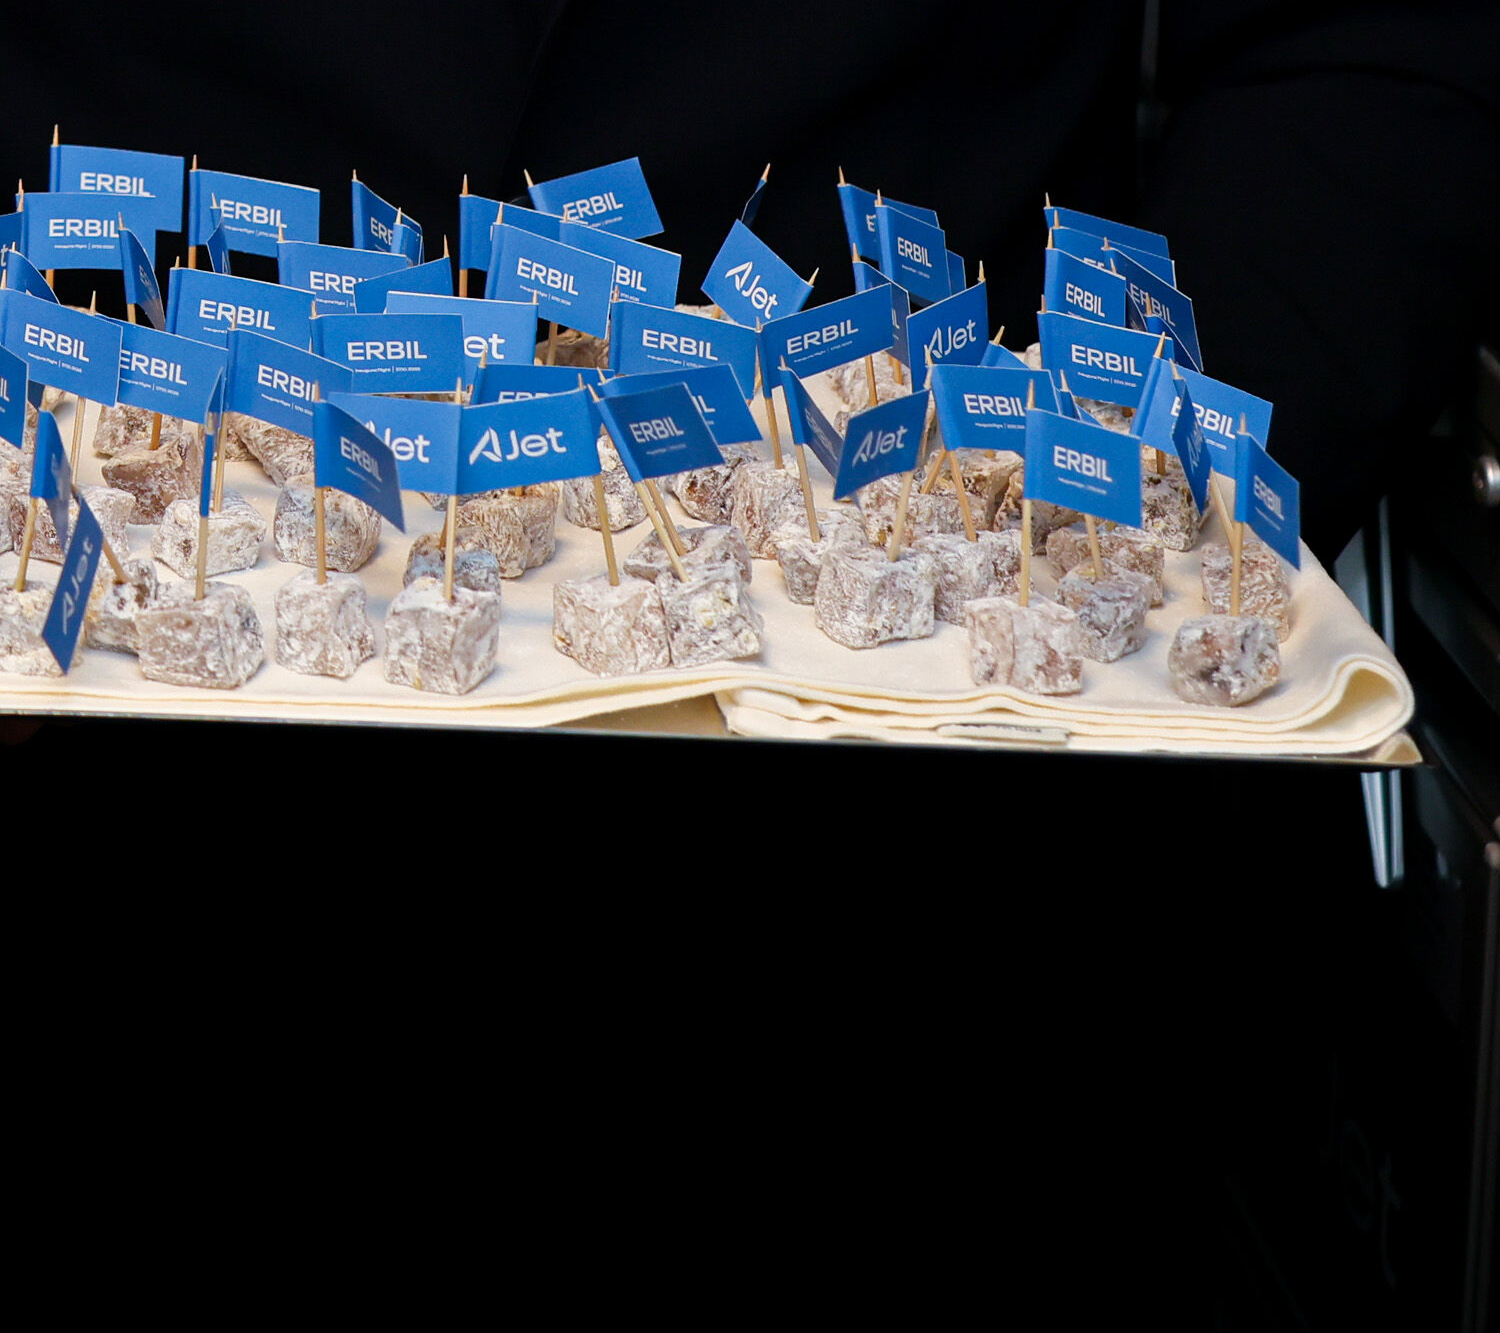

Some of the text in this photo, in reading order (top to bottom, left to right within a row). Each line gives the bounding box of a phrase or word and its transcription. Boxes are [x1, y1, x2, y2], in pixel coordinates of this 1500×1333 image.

[80, 171, 153, 197] ERBIL
[220, 199, 288, 228] ERBIL
[562, 191, 624, 223] ERBIL
[49, 218, 119, 238] ERBIL
[897, 236, 933, 269] ERBIL
[516, 257, 579, 296] ERBIL
[724, 261, 779, 319] AJet
[199, 299, 276, 331] ERBIL
[1065, 282, 1106, 318] ERBIL
[24, 323, 90, 362] ERBIL
[347, 340, 428, 361] ERBIL
[642, 328, 719, 362] ERBIL
[786, 319, 859, 355] ERBIL
[928, 319, 977, 359] AJet
[1071, 343, 1143, 377] ERBIL
[964, 393, 1025, 417] ERBIL
[364, 420, 431, 464] Jet
[469, 426, 567, 466] AJet
[629, 416, 685, 444] ERBIL
[852, 425, 908, 468] AJet
[340, 436, 383, 482] ERBIL
[1053, 445, 1113, 483] ERBIL
